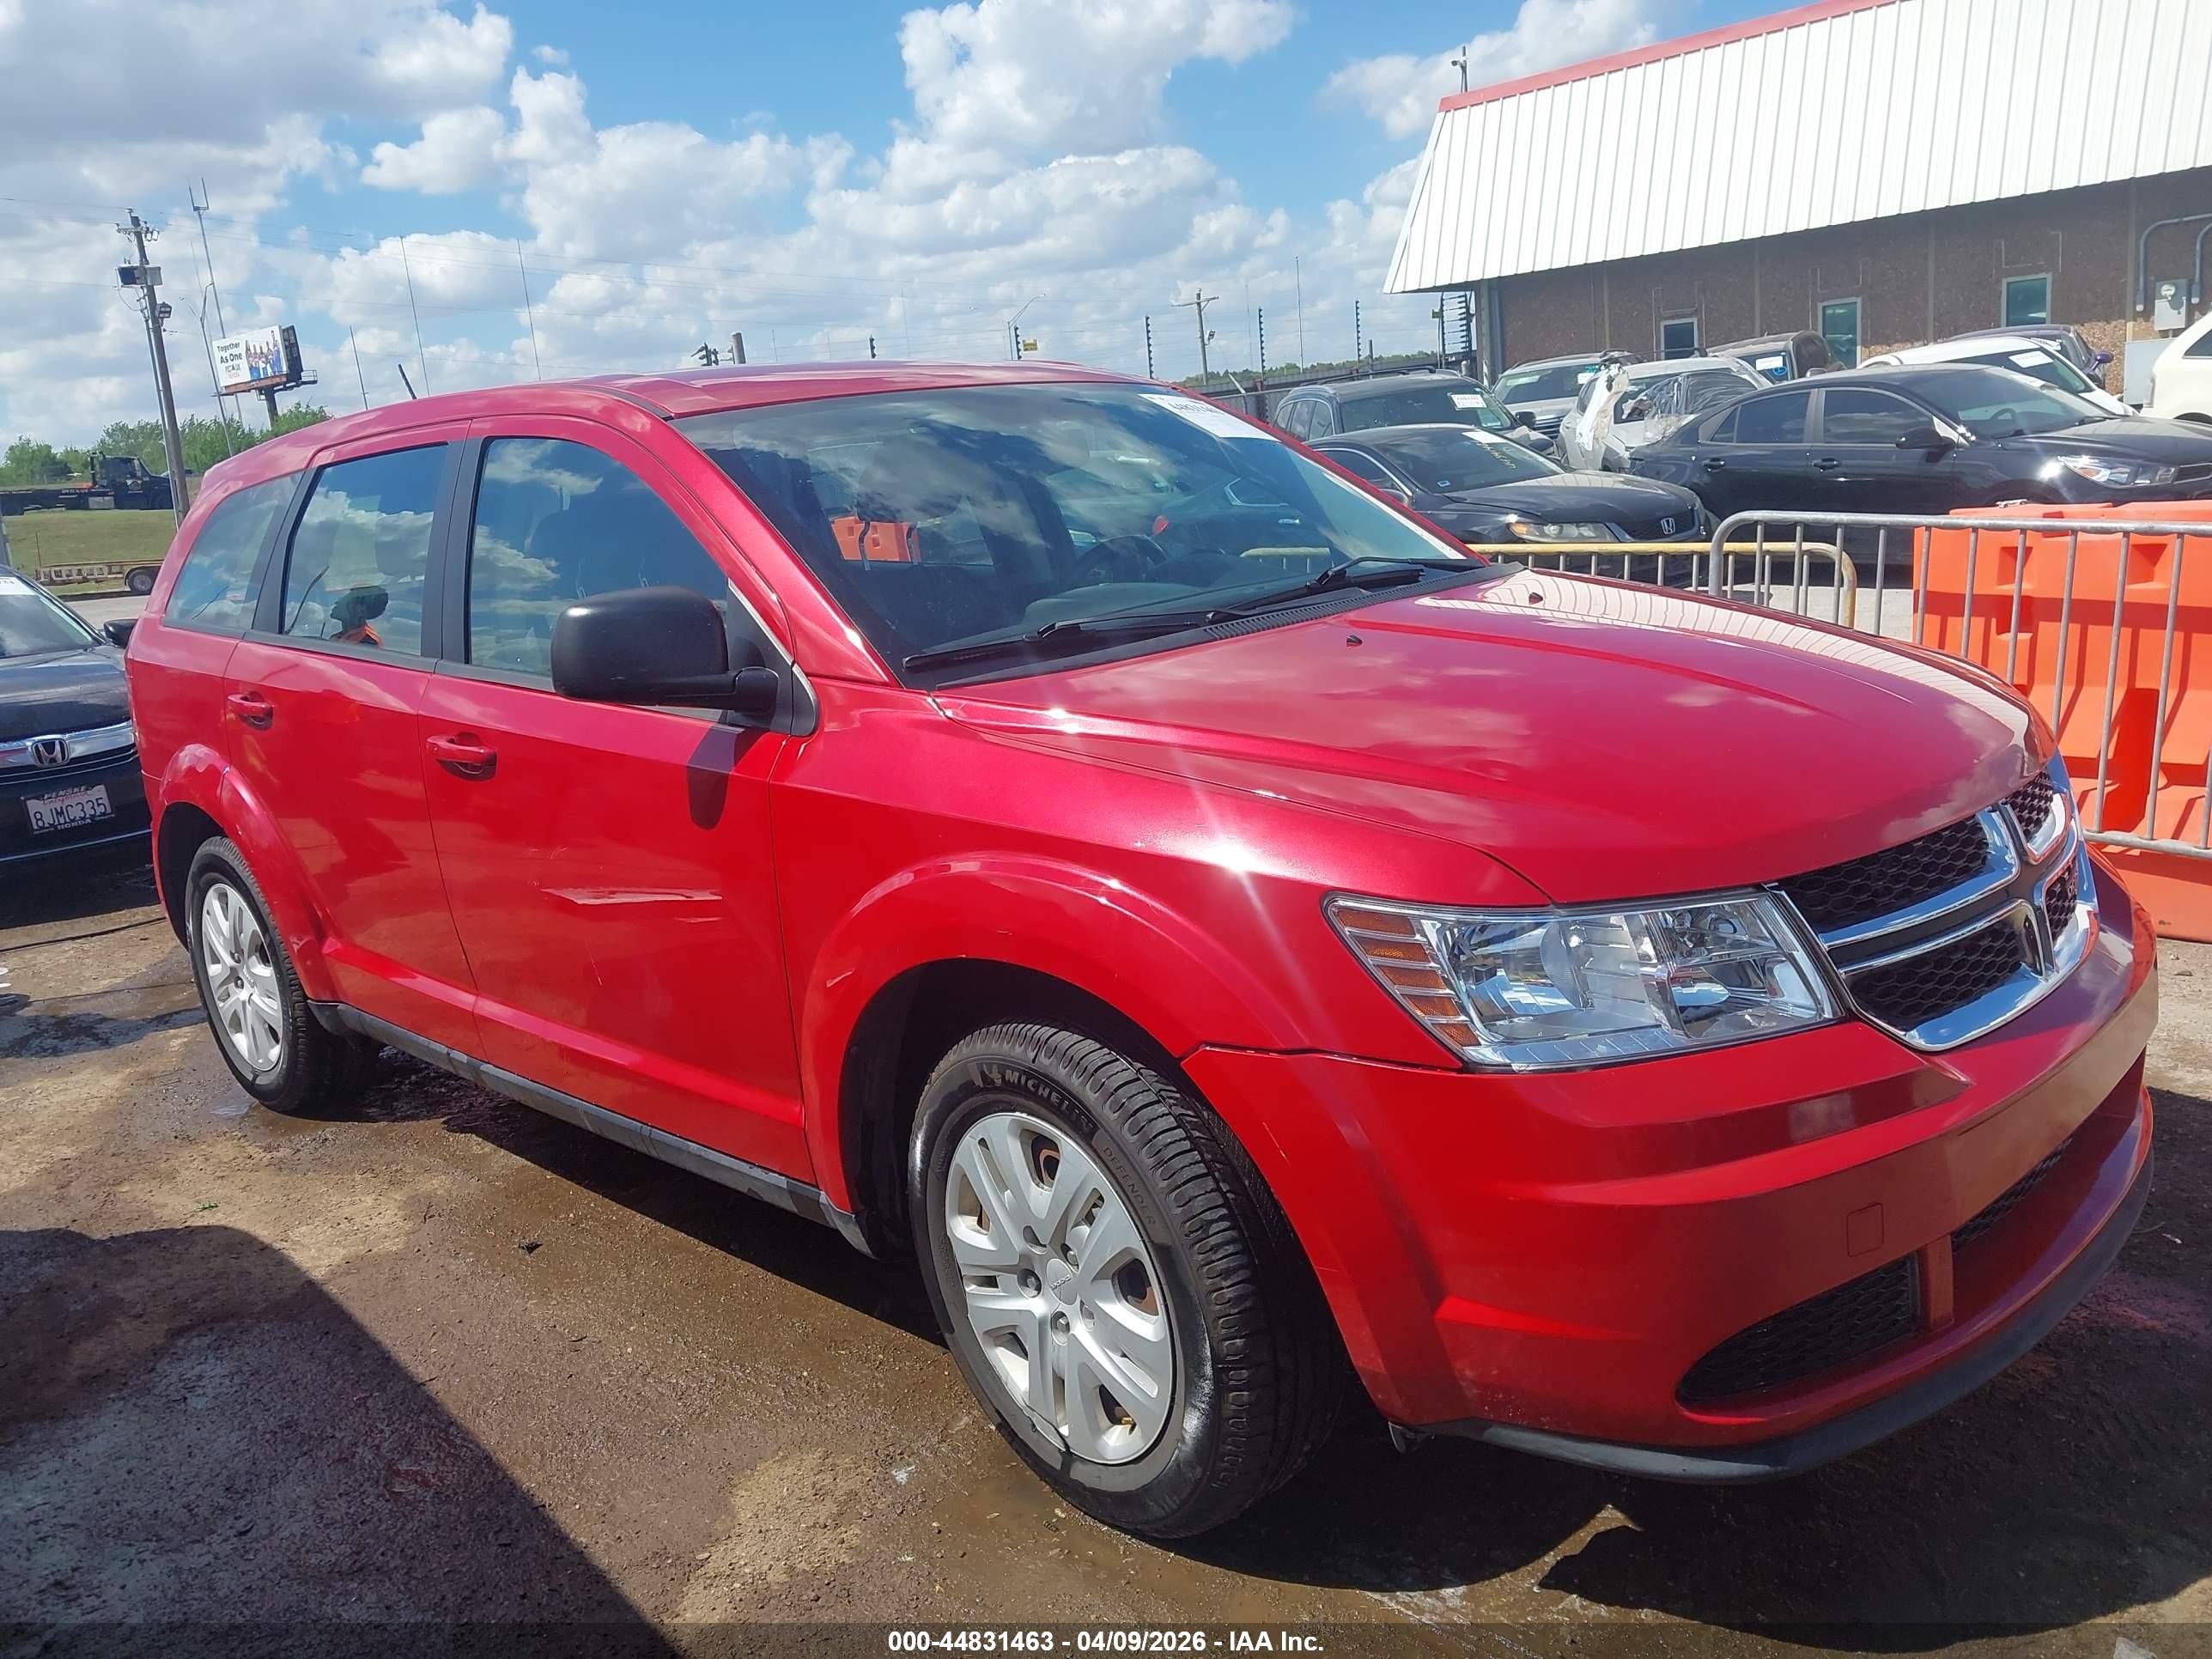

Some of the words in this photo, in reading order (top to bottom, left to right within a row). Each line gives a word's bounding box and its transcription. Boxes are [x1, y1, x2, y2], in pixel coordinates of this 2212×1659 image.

[216, 342, 240, 353] Together
[220, 356, 229, 364] As
[229, 352, 243, 362] One
[33, 797, 107, 829] 8JMC335
